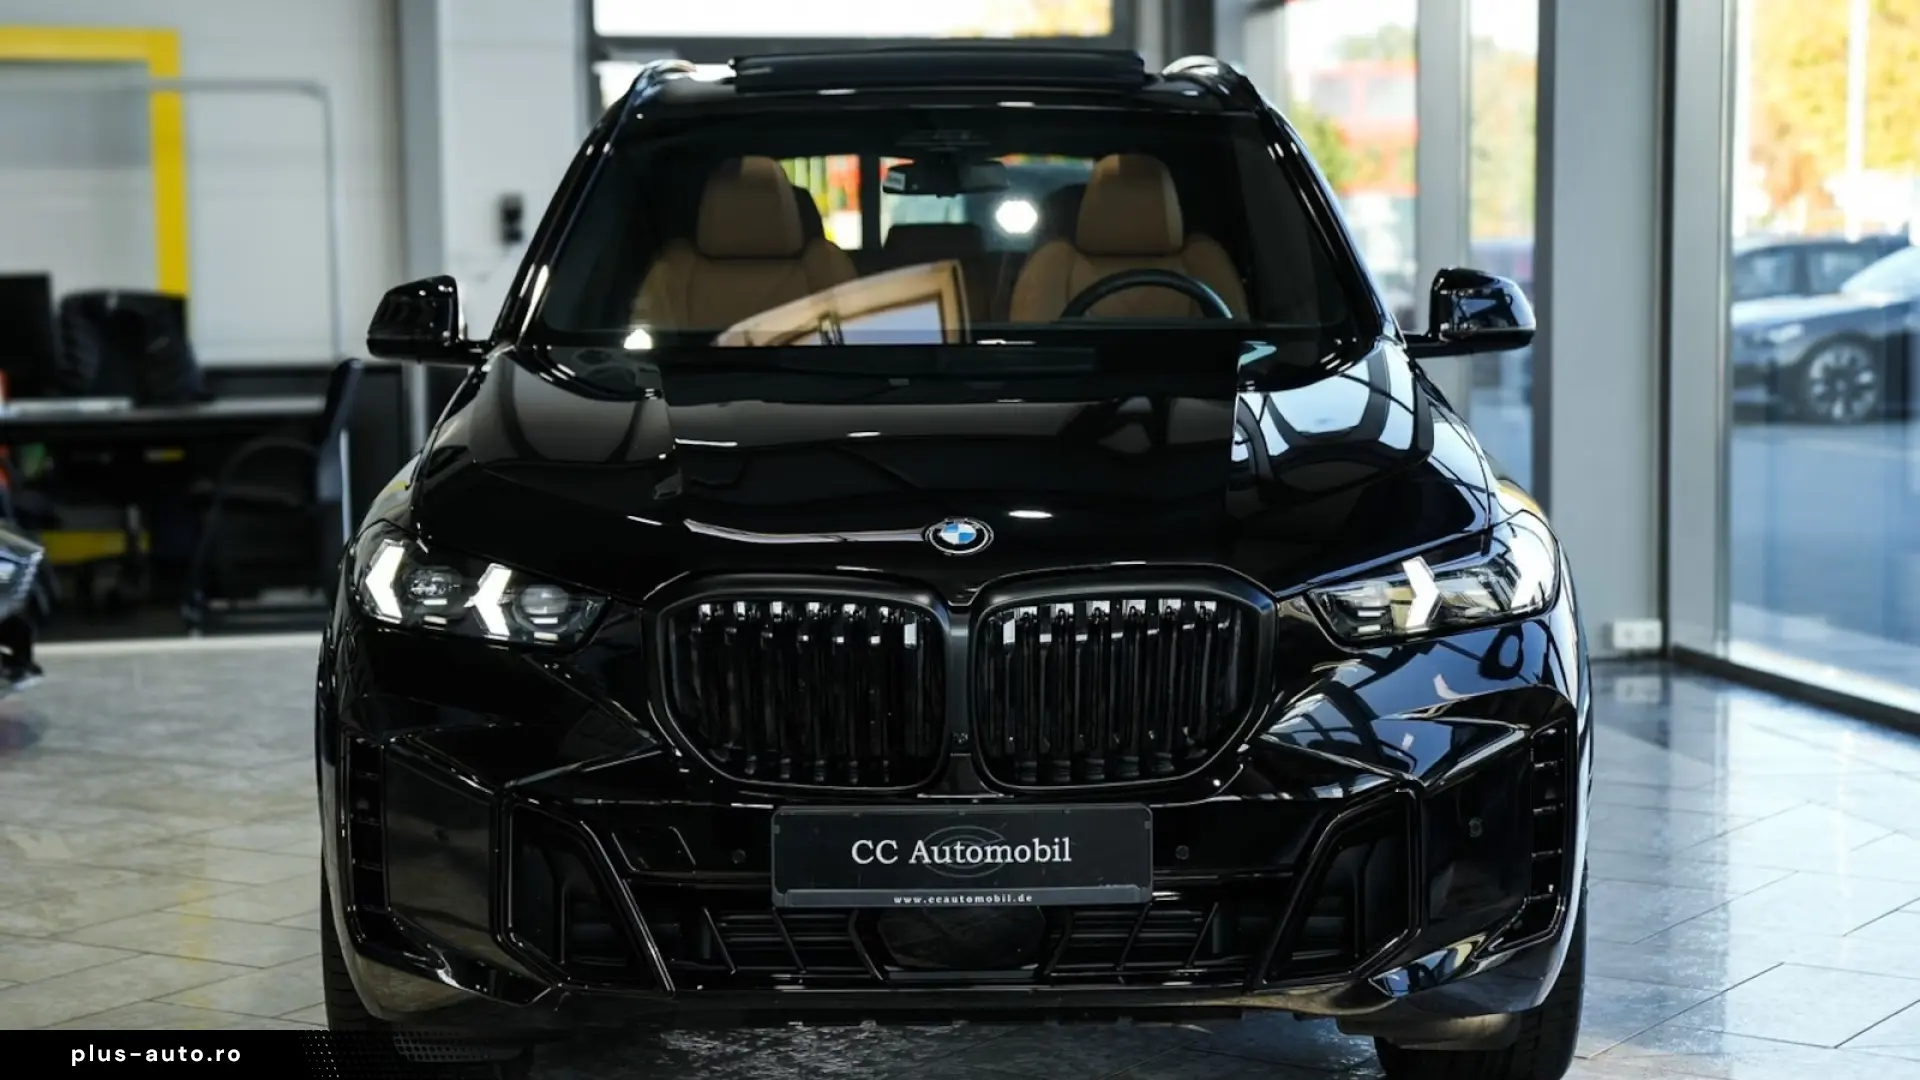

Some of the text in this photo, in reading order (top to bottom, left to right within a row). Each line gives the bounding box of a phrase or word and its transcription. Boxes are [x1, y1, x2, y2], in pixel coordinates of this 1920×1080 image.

[851, 836, 1072, 865] CC Automobil
[893, 893, 1033, 905] www.ccautomobil.de
